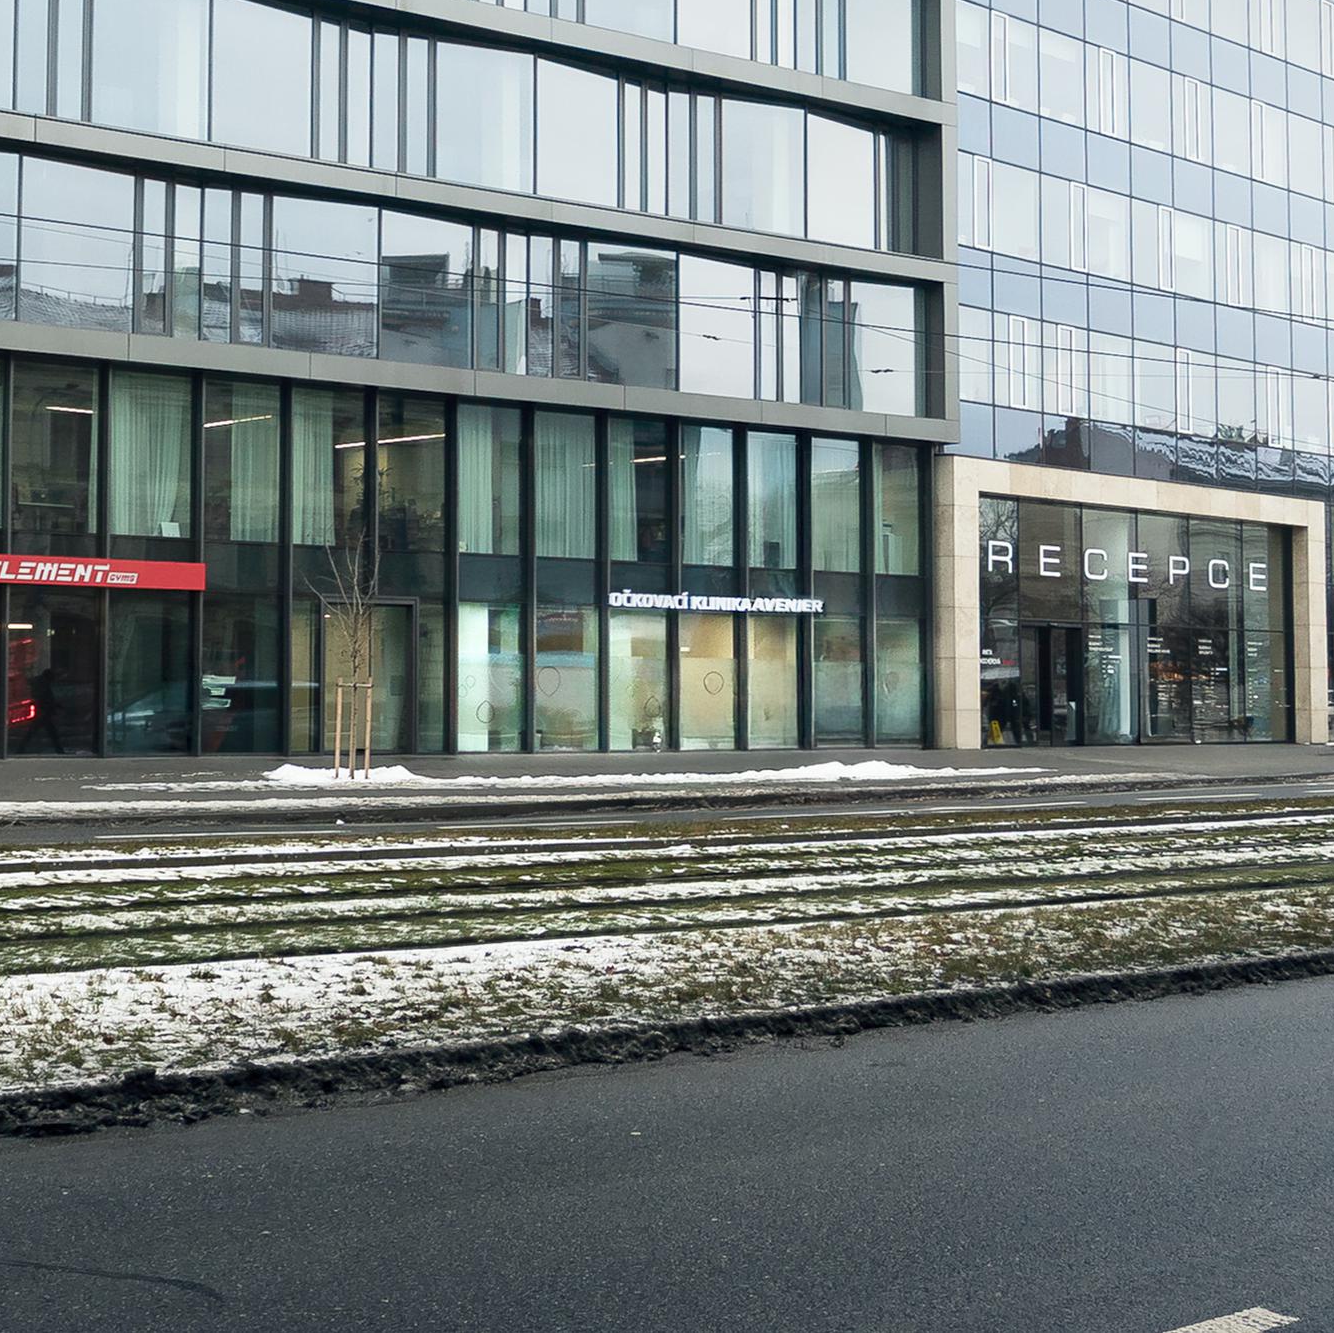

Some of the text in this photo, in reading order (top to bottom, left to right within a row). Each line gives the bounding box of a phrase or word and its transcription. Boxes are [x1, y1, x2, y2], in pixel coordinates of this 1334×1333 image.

[987, 540, 1268, 592] RECEPCE
[609, 589, 825, 613] OČKOVACÍ KLINIKA AVENIER
